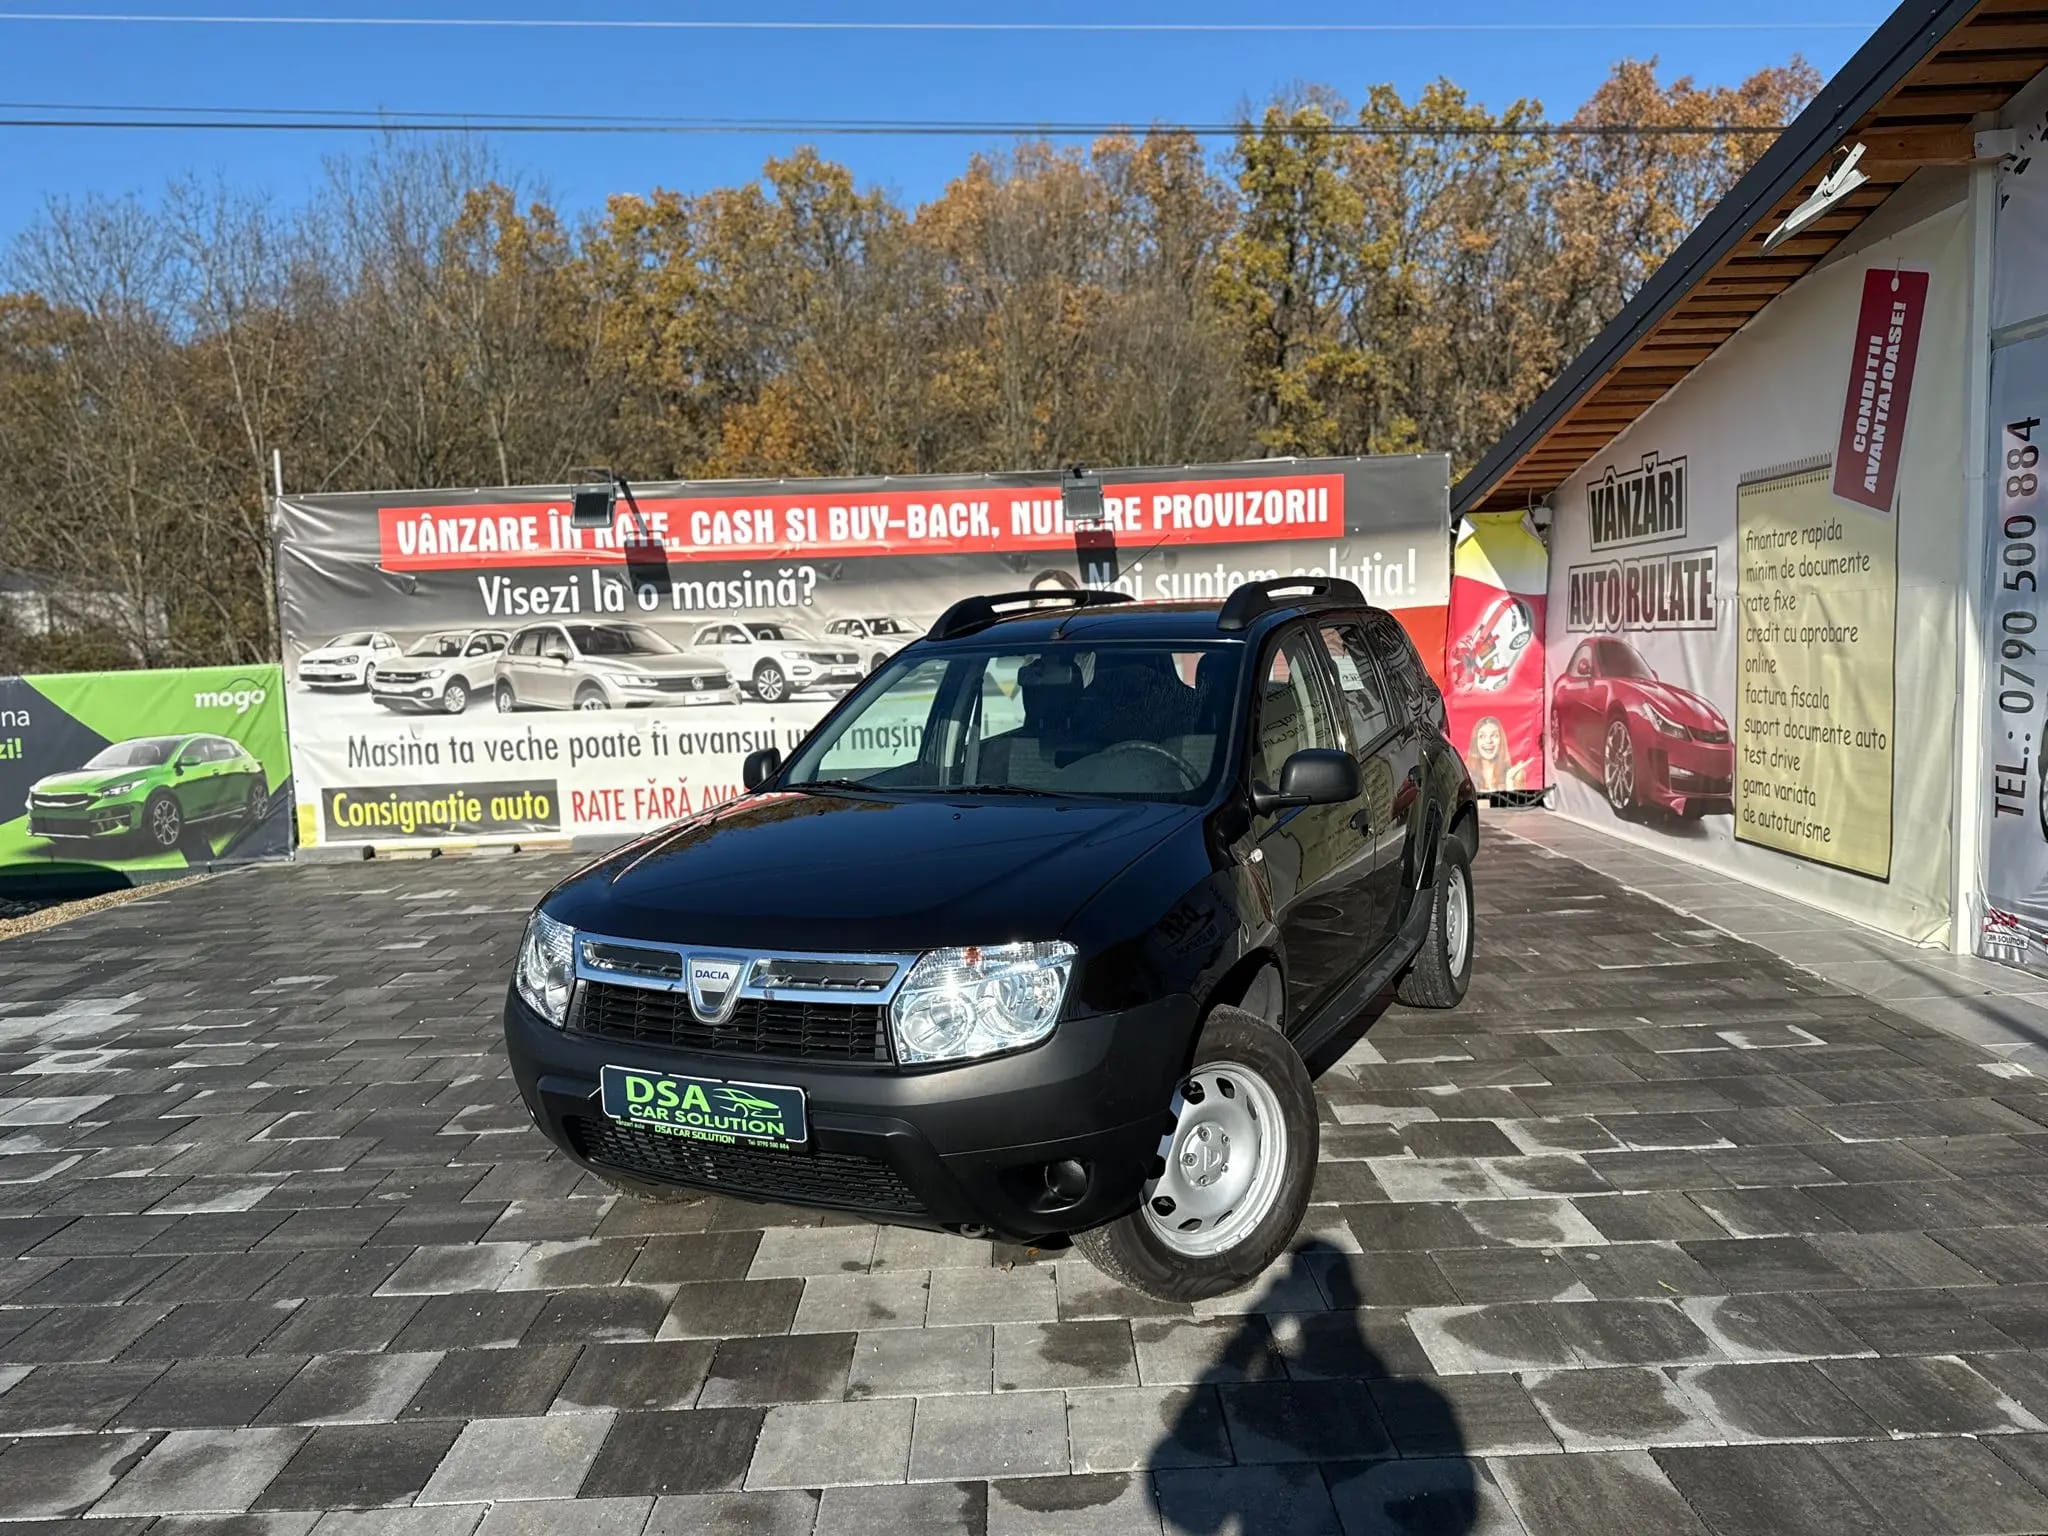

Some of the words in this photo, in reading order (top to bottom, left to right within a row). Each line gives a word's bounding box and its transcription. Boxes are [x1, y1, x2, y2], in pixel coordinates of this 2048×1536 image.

[1853, 335, 1884, 453] CONDITII
[1863, 301, 1907, 494] AVANTAJOASE!
[2006, 415, 2041, 499] 884
[396, 512, 540, 555] VÂNZARE
[547, 508, 582, 551] ÎN
[691, 508, 775, 546] CASH
[828, 501, 1000, 542] BUY-BACK,
[1010, 496, 1142, 536] NURE
[1153, 487, 1328, 531] PROVIZORII
[1590, 461, 1683, 544] VÂNZĂRI
[1745, 529, 1798, 553] finantare
[1801, 517, 1843, 550] rapida
[2002, 513, 2038, 593] 500
[1088, 562, 1144, 600] Noi
[1746, 560, 1777, 583] minim
[1780, 556, 1796, 580] de
[1800, 551, 1871, 578] documente
[477, 574, 581, 616] Visezi
[591, 569, 625, 613] la
[637, 583, 660, 612] o
[1569, 567, 1621, 627] AUTO
[1626, 556, 1713, 624] RULATE
[1745, 593, 1770, 613] rate
[1773, 589, 1797, 613] fixe
[1745, 622, 1780, 643] credit
[1783, 630, 1797, 643] cu
[1800, 620, 1859, 649] aprobare
[1745, 651, 1777, 674] online
[1998, 609, 2038, 715] 0790
[194, 686, 266, 714] mogo
[1745, 682, 1787, 706] factura
[1790, 684, 1830, 710] fiscala
[448, 736, 475, 764] ta
[484, 726, 559, 762] veche
[569, 732, 642, 768] poate
[1744, 717, 1780, 741] suport
[1783, 717, 1852, 746] documente
[1855, 728, 1887, 750] auto
[1744, 744, 1767, 765] test
[1770, 747, 1801, 772] drive
[571, 788, 627, 823] RATE
[634, 776, 693, 820] FĂRĂ
[1743, 778, 1771, 799] gama
[1773, 782, 1817, 807] variata
[332, 791, 482, 834] Consignație
[490, 790, 550, 821] auto
[1743, 803, 1756, 824] de
[1758, 809, 1832, 843] autoturisme
[694, 969, 730, 981] DACIA
[625, 1075, 712, 1113] DSA
[628, 1102, 670, 1121] CAR
[674, 1109, 785, 1136] SOLUTION
[654, 1125, 673, 1136] DSA
[673, 1126, 692, 1139] CAR
[691, 1129, 736, 1145] SOLUTION
